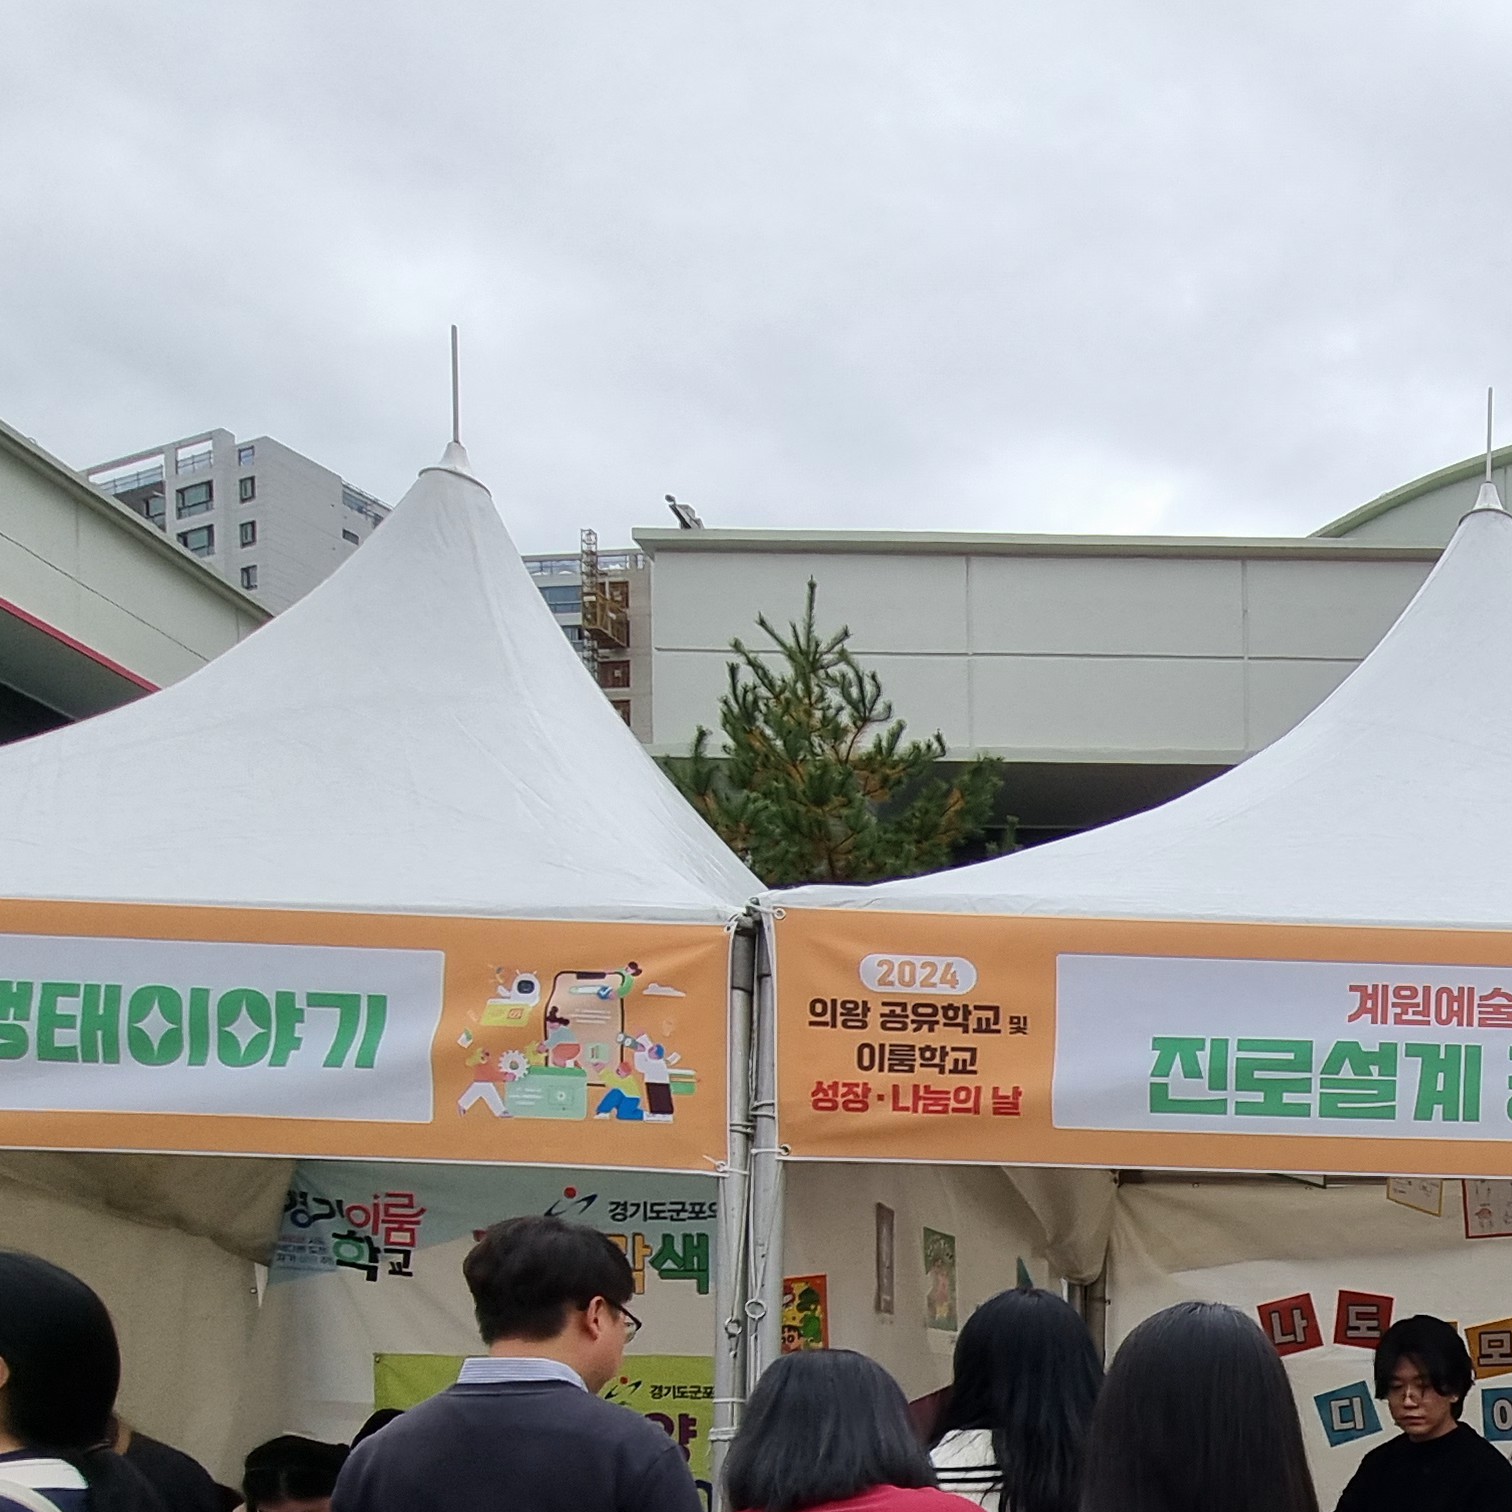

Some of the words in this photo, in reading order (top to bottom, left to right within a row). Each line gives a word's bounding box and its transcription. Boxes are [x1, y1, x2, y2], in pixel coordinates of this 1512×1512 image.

[875, 959, 959, 990] 2024
[808, 999, 871, 1031] 의왕
[880, 1001, 1001, 1034] 공유학교
[1009, 1014, 1029, 1036] 및
[856, 1043, 978, 1076] 이룸학교
[1148, 1035, 1483, 1123] 진로설계
[992, 1085, 1022, 1118] 날
[331, 1229, 415, 1283] 학교
